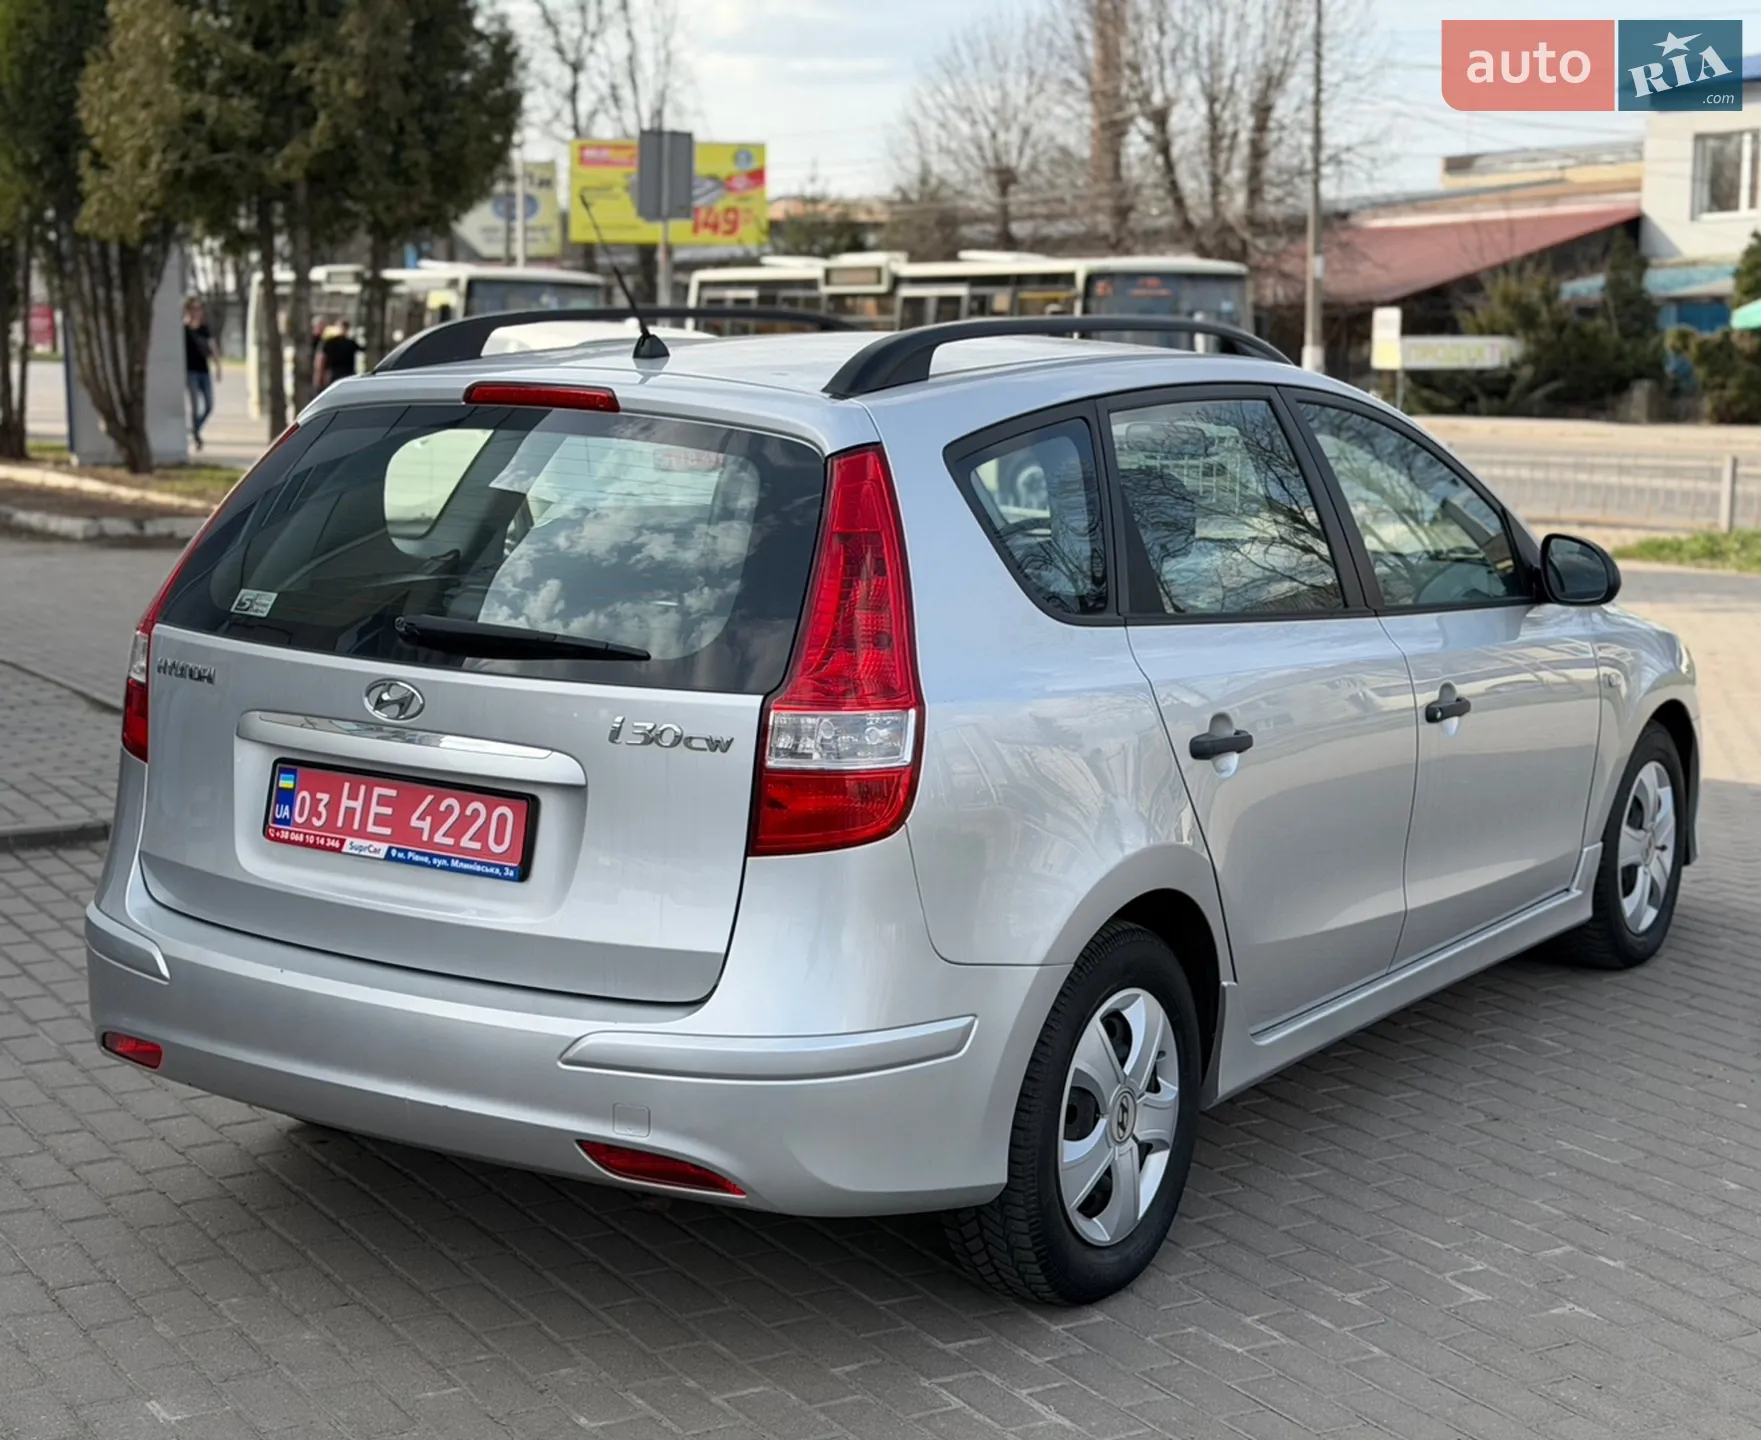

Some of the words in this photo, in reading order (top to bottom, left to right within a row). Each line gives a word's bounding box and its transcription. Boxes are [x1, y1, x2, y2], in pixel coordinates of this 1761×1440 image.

[692, 206, 741, 237] 149
[156, 656, 216, 686] HYUNDAI
[275, 803, 291, 820] UA
[294, 790, 331, 828] 03
[409, 793, 514, 855] 4220
[349, 841, 381, 855] SuprCar
